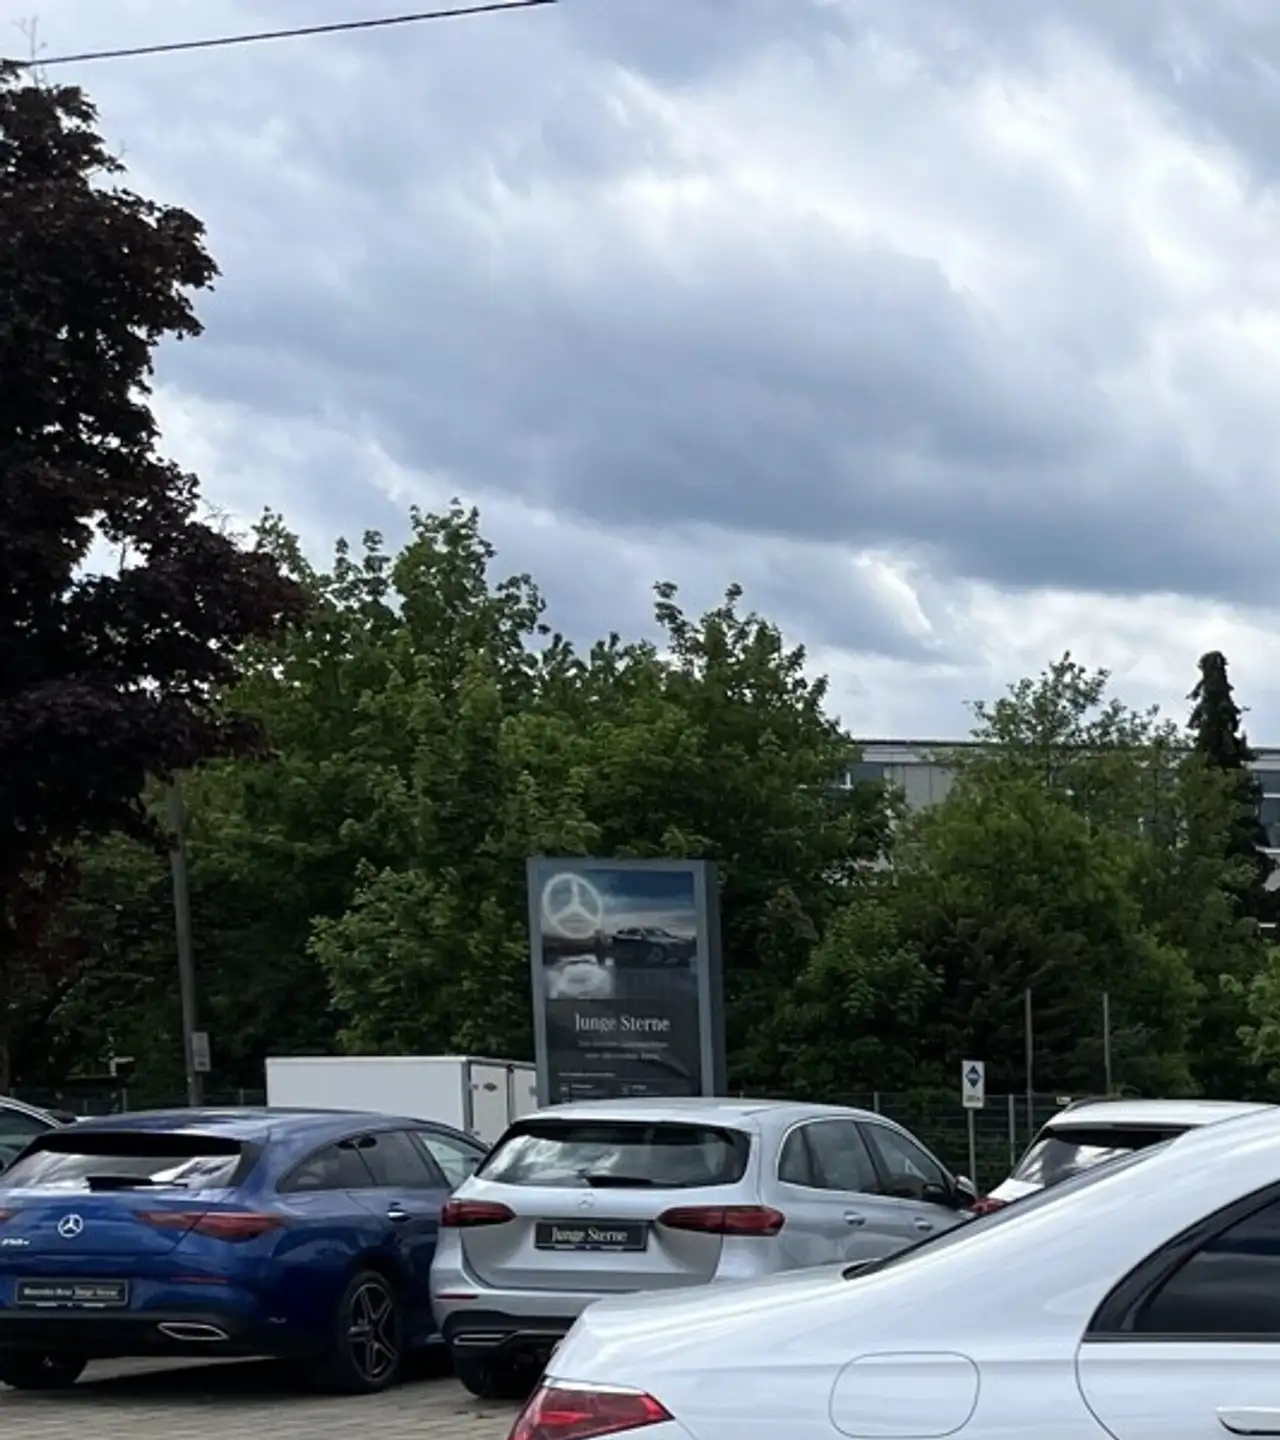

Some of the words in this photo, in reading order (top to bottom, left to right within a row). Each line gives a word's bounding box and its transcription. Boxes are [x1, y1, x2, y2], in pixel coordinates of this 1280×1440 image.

[575, 1012, 616, 1032] Junge
[620, 1014, 671, 1032] Sterne
[551, 1226, 585, 1242] Junge
[587, 1227, 628, 1242] Sterne
